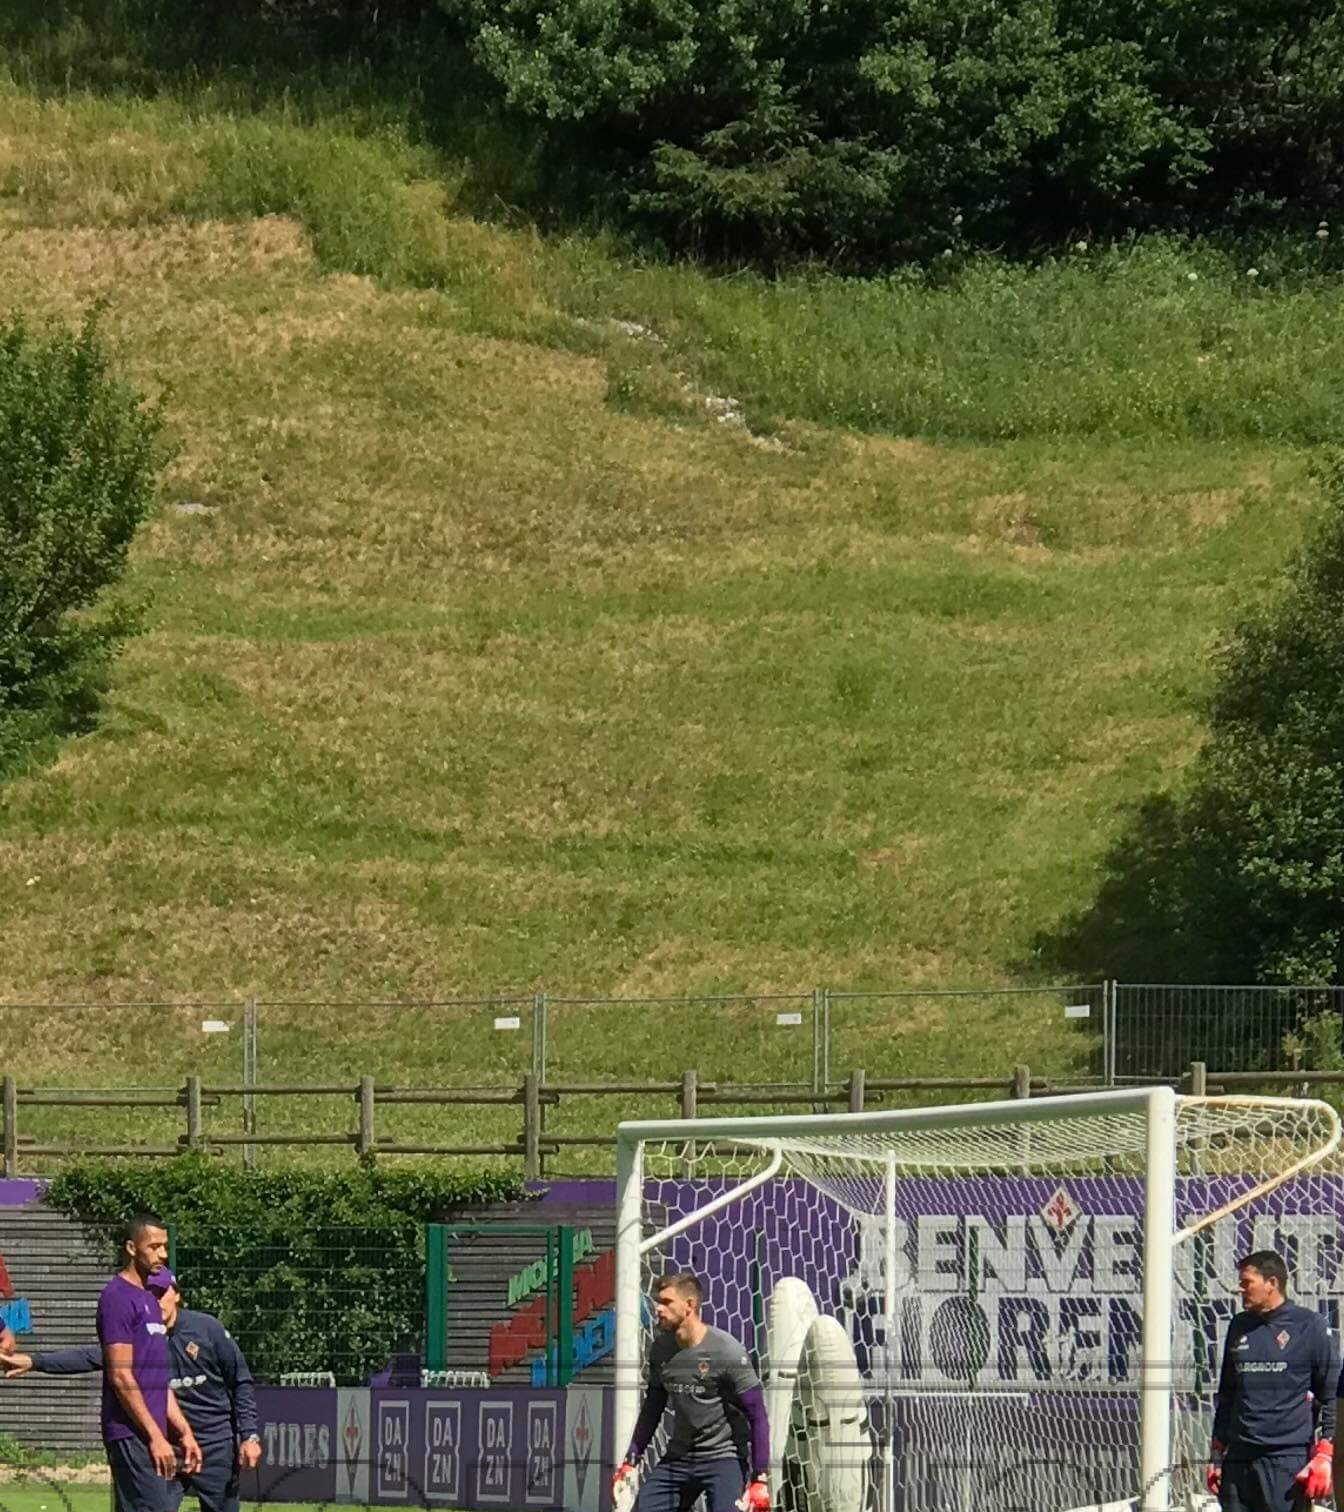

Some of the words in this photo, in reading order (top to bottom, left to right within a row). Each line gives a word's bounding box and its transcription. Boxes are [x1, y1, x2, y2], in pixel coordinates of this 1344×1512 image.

[263, 1422, 330, 1470] TIRES
[384, 1416, 402, 1446] DA
[433, 1416, 453, 1447] DA
[486, 1417, 506, 1449] DA
[533, 1417, 550, 1449] DA
